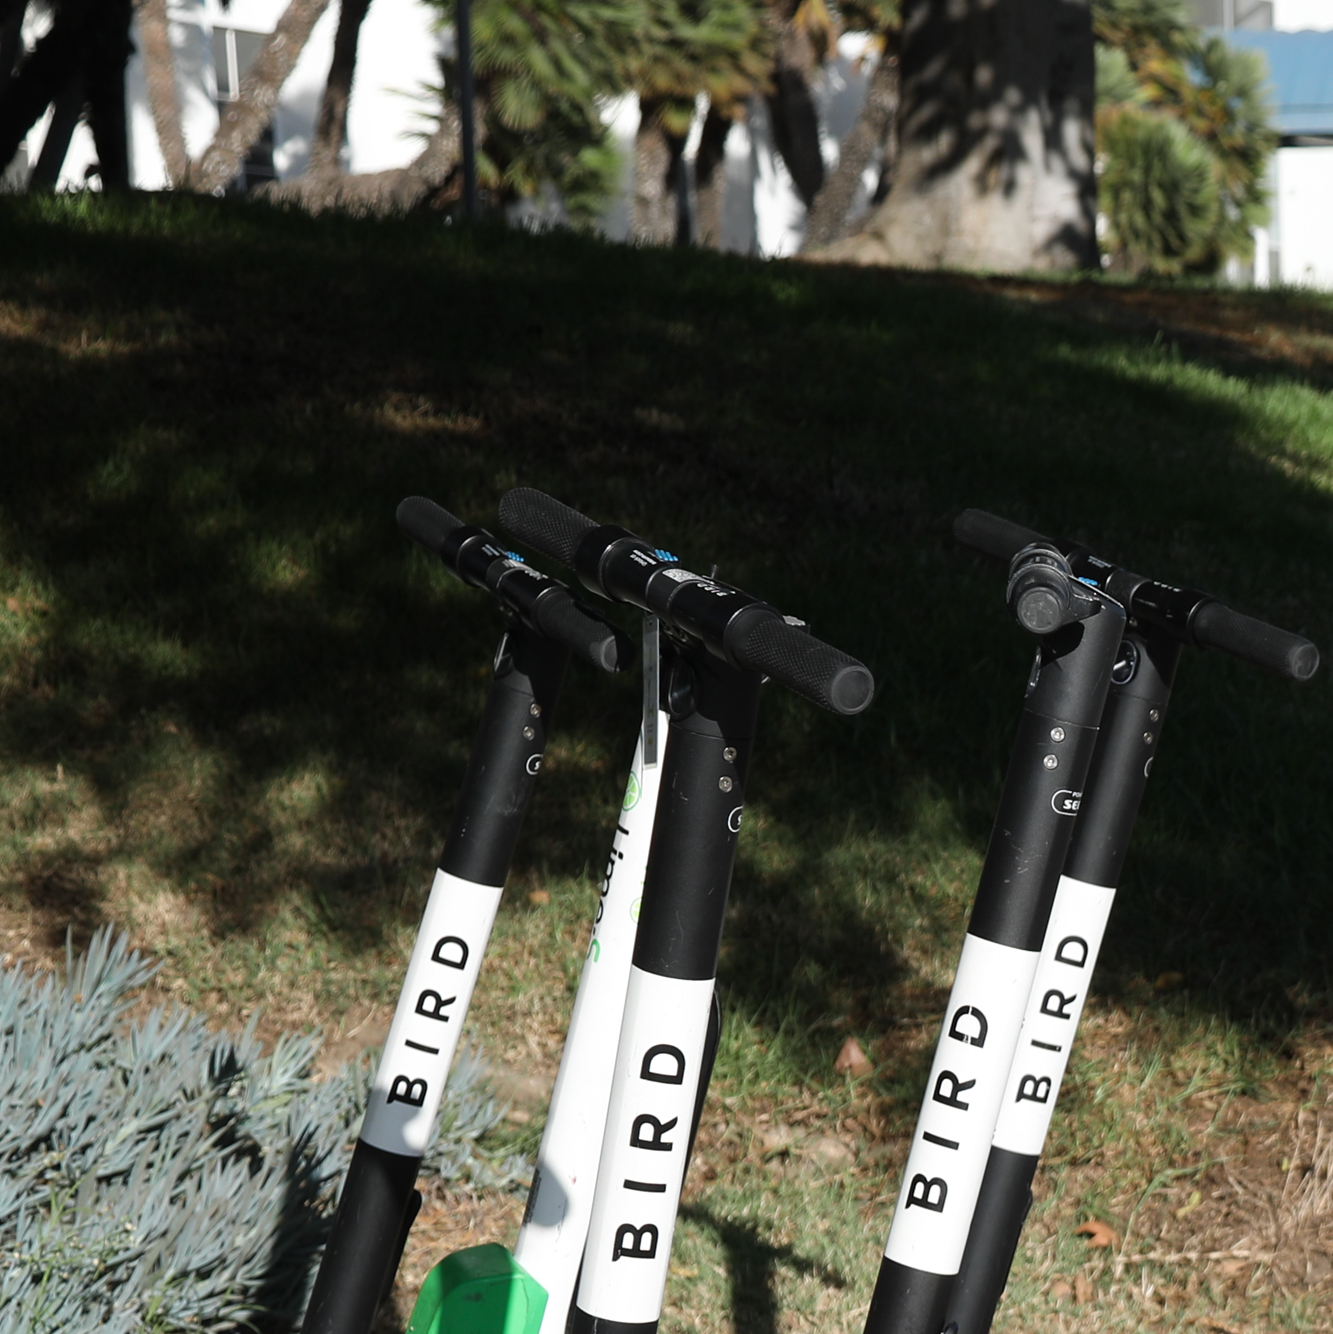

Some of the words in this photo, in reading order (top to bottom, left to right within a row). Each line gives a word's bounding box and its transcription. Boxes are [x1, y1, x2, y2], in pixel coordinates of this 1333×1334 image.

[386, 935, 469, 1108] BIRD
[905, 1005, 988, 1213] BIRD
[1015, 935, 1089, 1104] BIRD
[612, 1043, 686, 1262] BIRD
